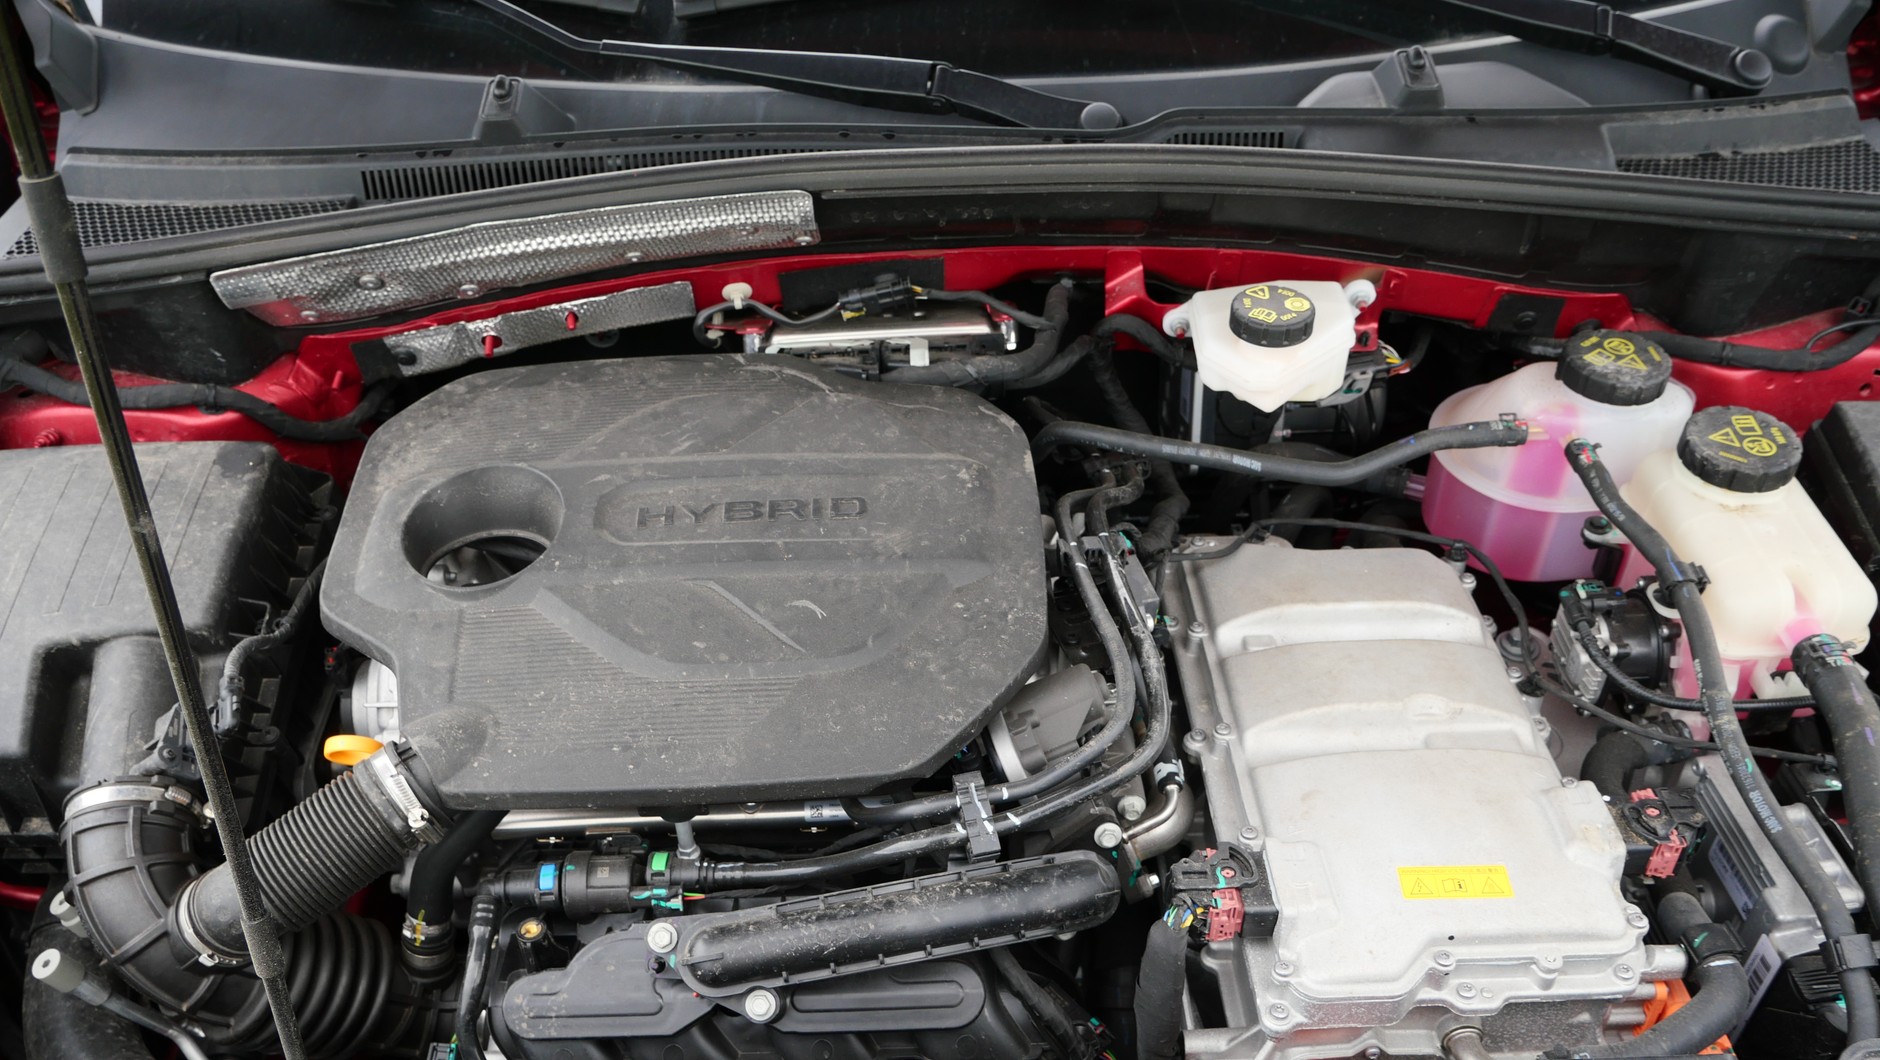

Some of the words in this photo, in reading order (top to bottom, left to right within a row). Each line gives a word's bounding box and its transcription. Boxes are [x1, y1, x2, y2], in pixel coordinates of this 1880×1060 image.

[636, 496, 868, 529] HYBRID
[1748, 790, 1774, 819] MOTOR
[1764, 815, 1783, 834] SAIC
